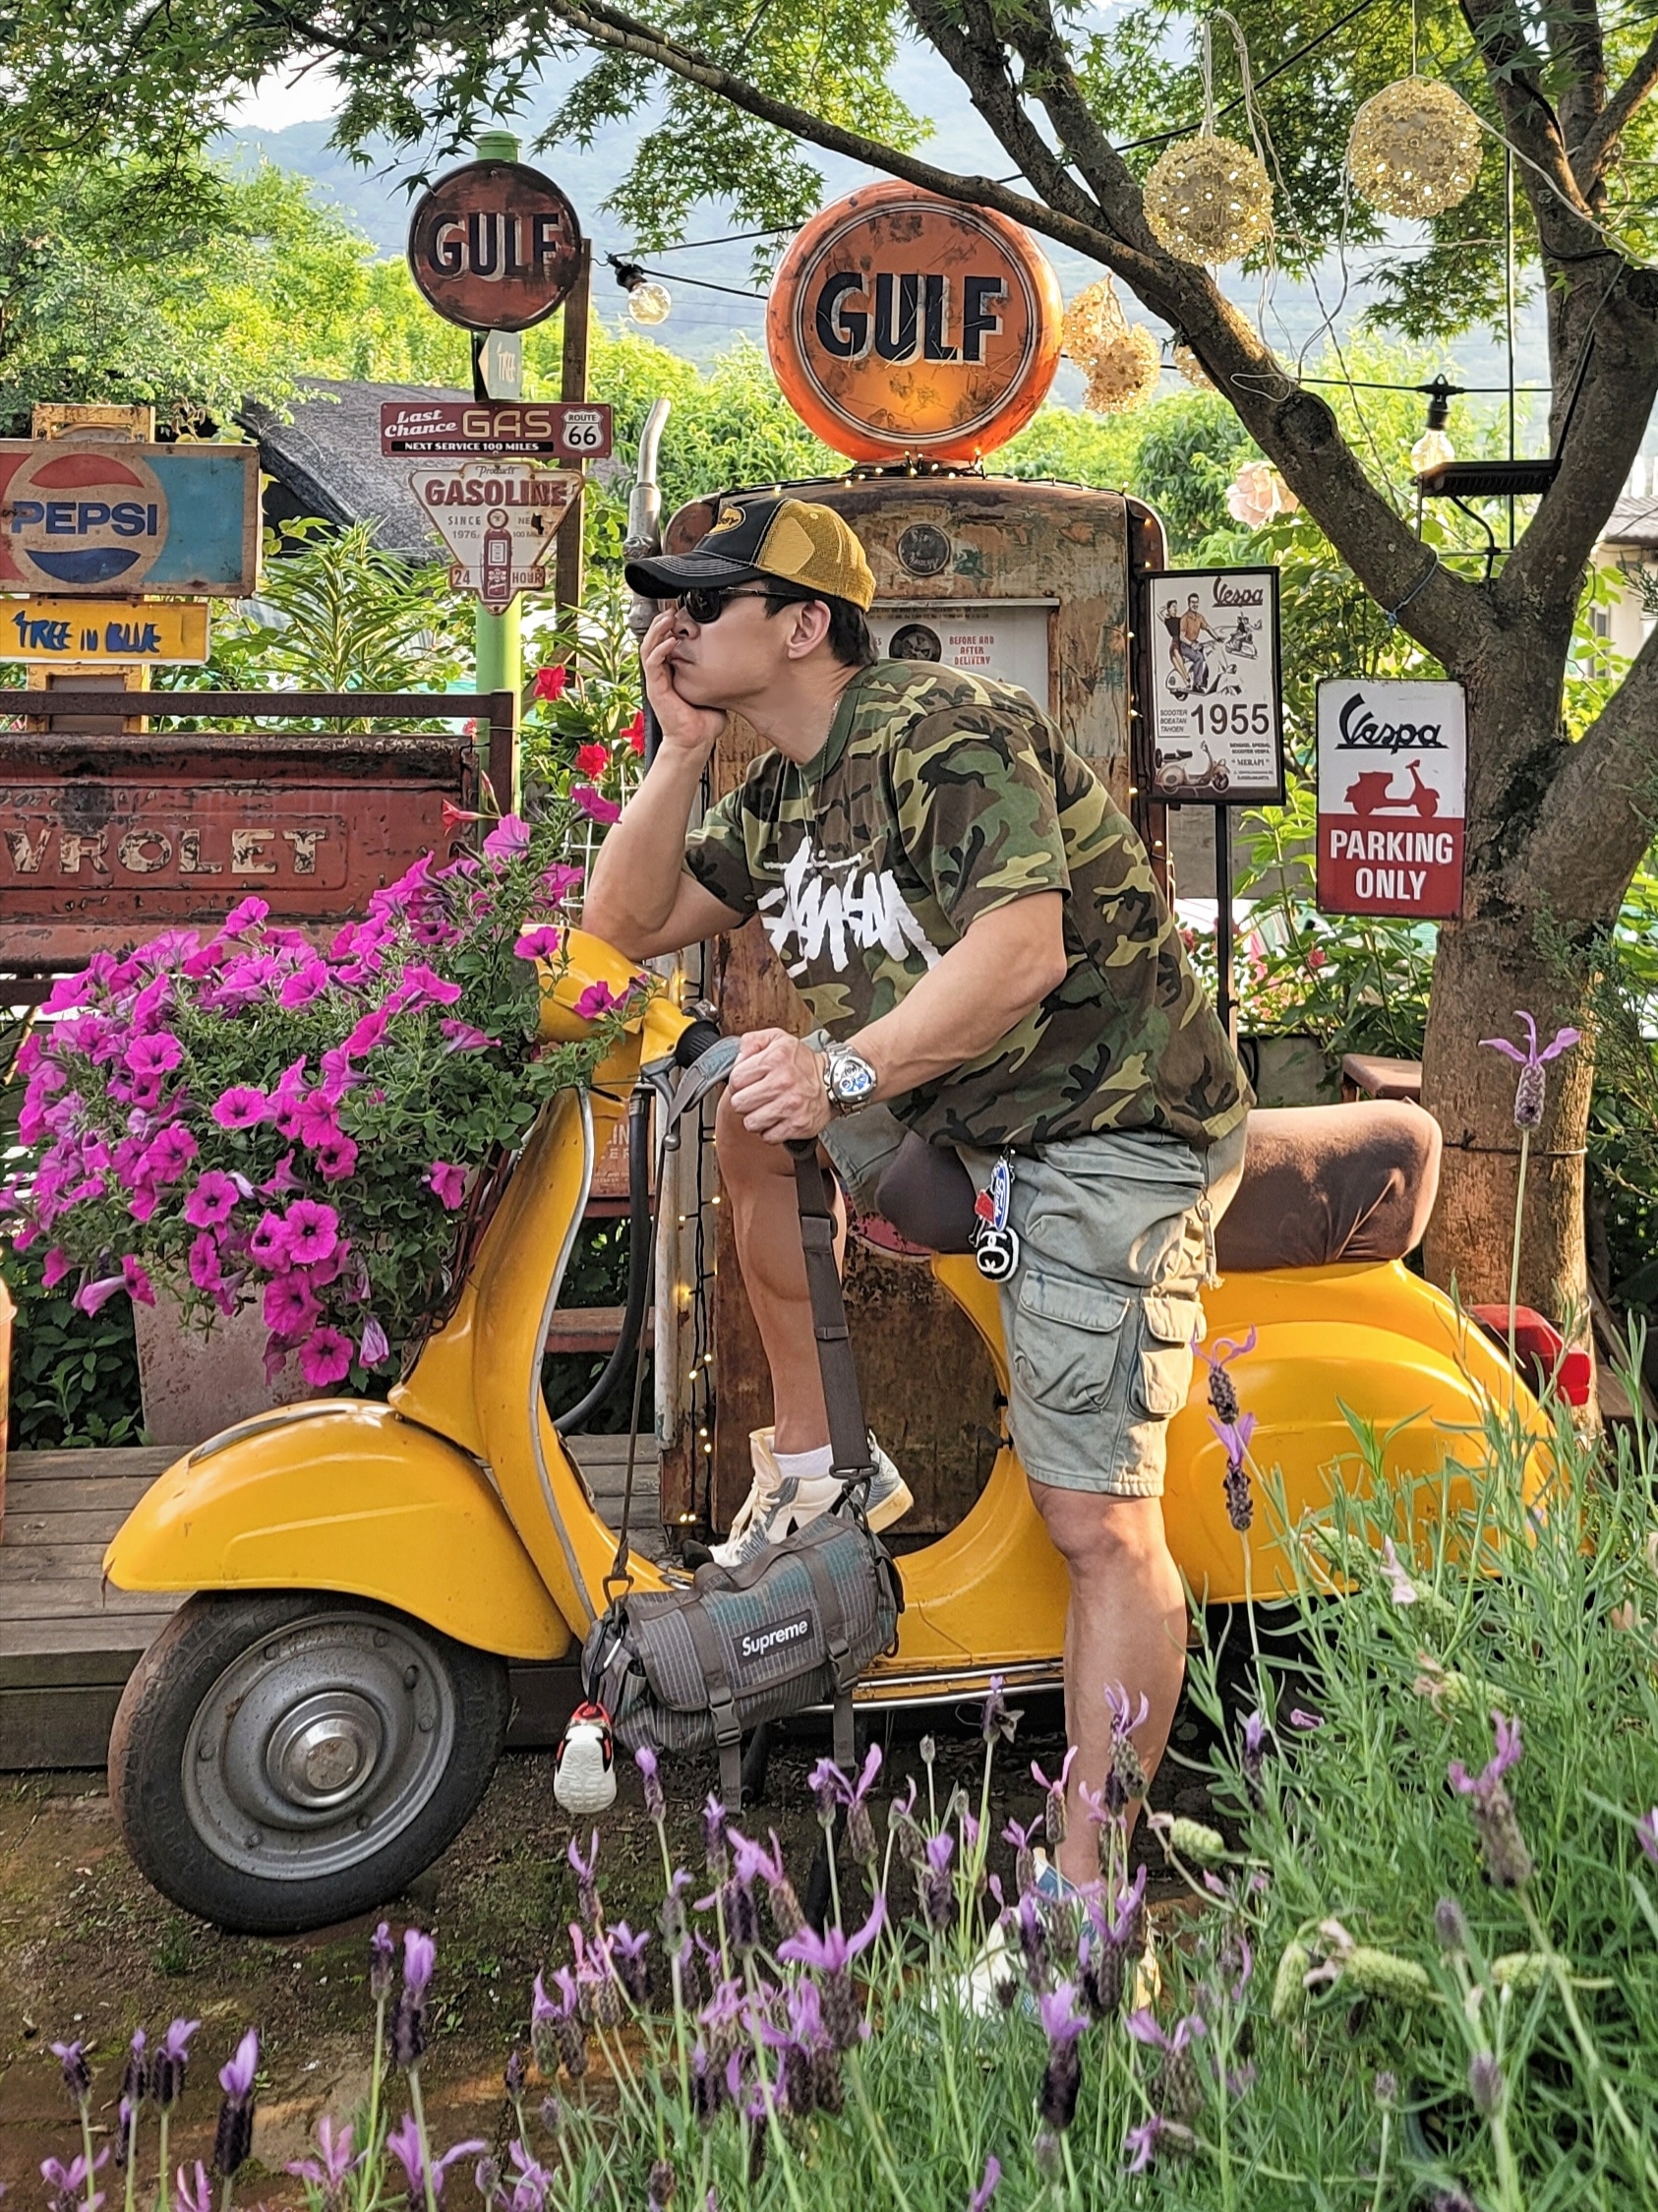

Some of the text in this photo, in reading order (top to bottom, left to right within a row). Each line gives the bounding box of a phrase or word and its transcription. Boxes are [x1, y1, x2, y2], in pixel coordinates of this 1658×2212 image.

[428, 211, 561, 281] GULF
[816, 271, 1008, 367] GULF
[385, 421, 458, 438] Chance
[397, 409, 443, 424] Last
[462, 410, 553, 438] GAS
[483, 443, 503, 451] 100
[568, 425, 597, 446] 66
[425, 479, 567, 507] GASOLINE
[11, 501, 157, 536] PEPSI
[447, 515, 481, 525] SINCE
[454, 569, 470, 585] 24
[512, 571, 541, 584] HOUR
[1212, 575, 1264, 608] Vespa
[106, 622, 161, 653] BLUE
[949, 635, 994, 645] BEFORE AND
[960, 646, 984, 655] AFTER
[954, 656, 990, 666] DELIVERY
[1191, 703, 1270, 735] 1955
[1334, 692, 1450, 754] Vespa
[1331, 829, 1453, 864] PARKING
[1355, 867, 1427, 901] ONLY
[742, 1621, 808, 1656] Supreme
